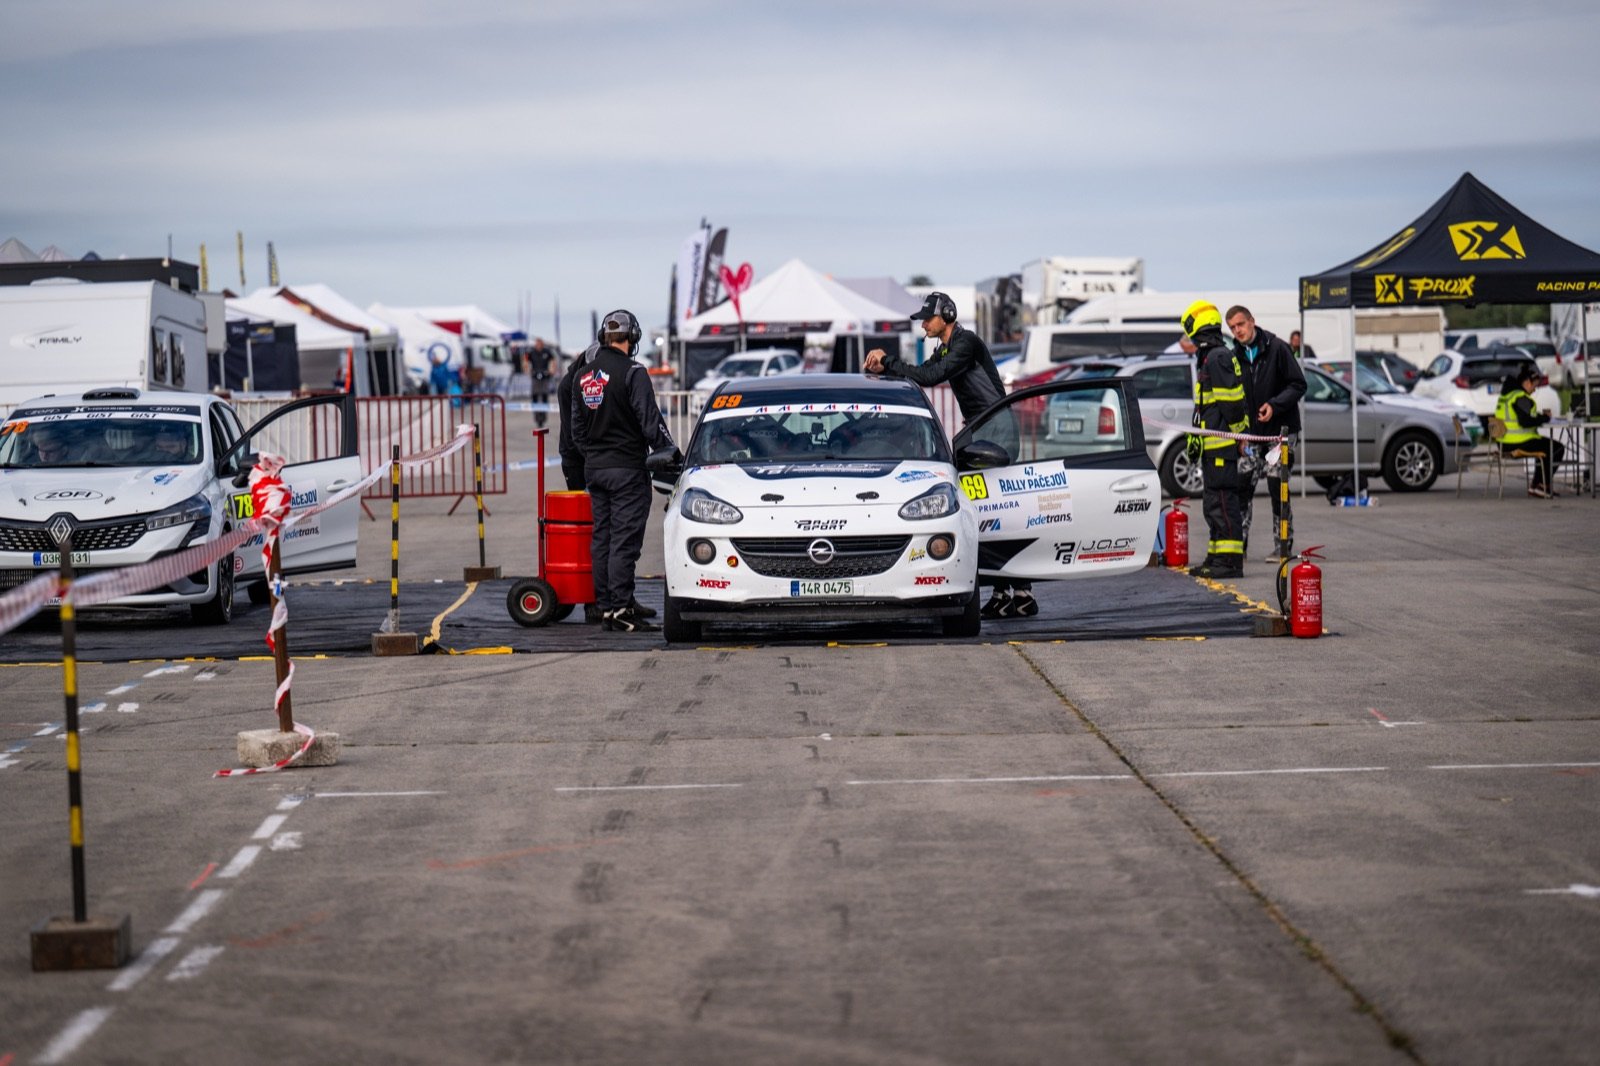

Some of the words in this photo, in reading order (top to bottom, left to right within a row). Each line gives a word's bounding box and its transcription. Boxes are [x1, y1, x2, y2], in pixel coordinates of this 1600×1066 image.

[1537, 282, 1585, 291] RACING
[712, 395, 743, 409] 69
[1024, 467, 1037, 476] 47.
[960, 474, 987, 500] 69
[999, 478, 1026, 493] RALLY
[1027, 471, 1067, 489] PAČEJOV
[46, 491, 92, 499] ZOFI
[290, 489, 317, 506] AČEJOV
[234, 494, 254, 519] 78
[979, 501, 1020, 512] PRIMAGRA
[1114, 501, 1152, 514] ALSTAV
[700, 579, 731, 589] MRF
[915, 576, 945, 585] MRF
[801, 582, 821, 594] 14R
[823, 582, 851, 594] 0475
